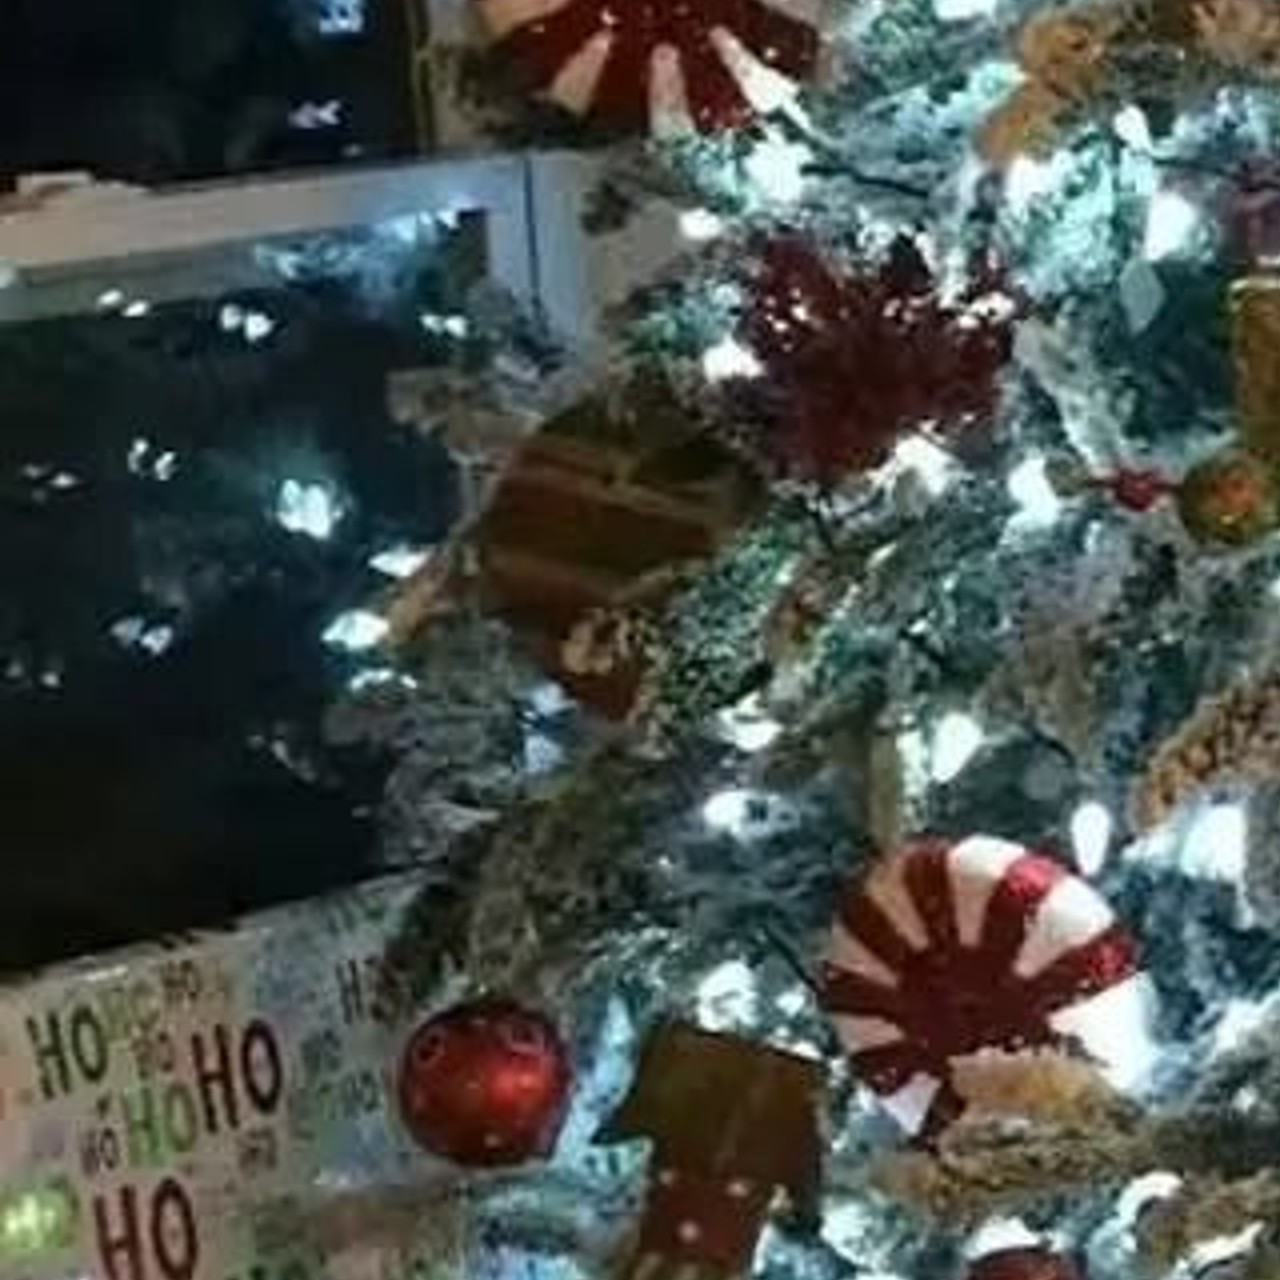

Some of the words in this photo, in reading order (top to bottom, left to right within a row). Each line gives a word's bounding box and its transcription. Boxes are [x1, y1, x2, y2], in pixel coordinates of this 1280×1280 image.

[26, 1007, 108, 1100] HO
[191, 1019, 283, 1134] HO
[124, 1082, 197, 1167] HO
